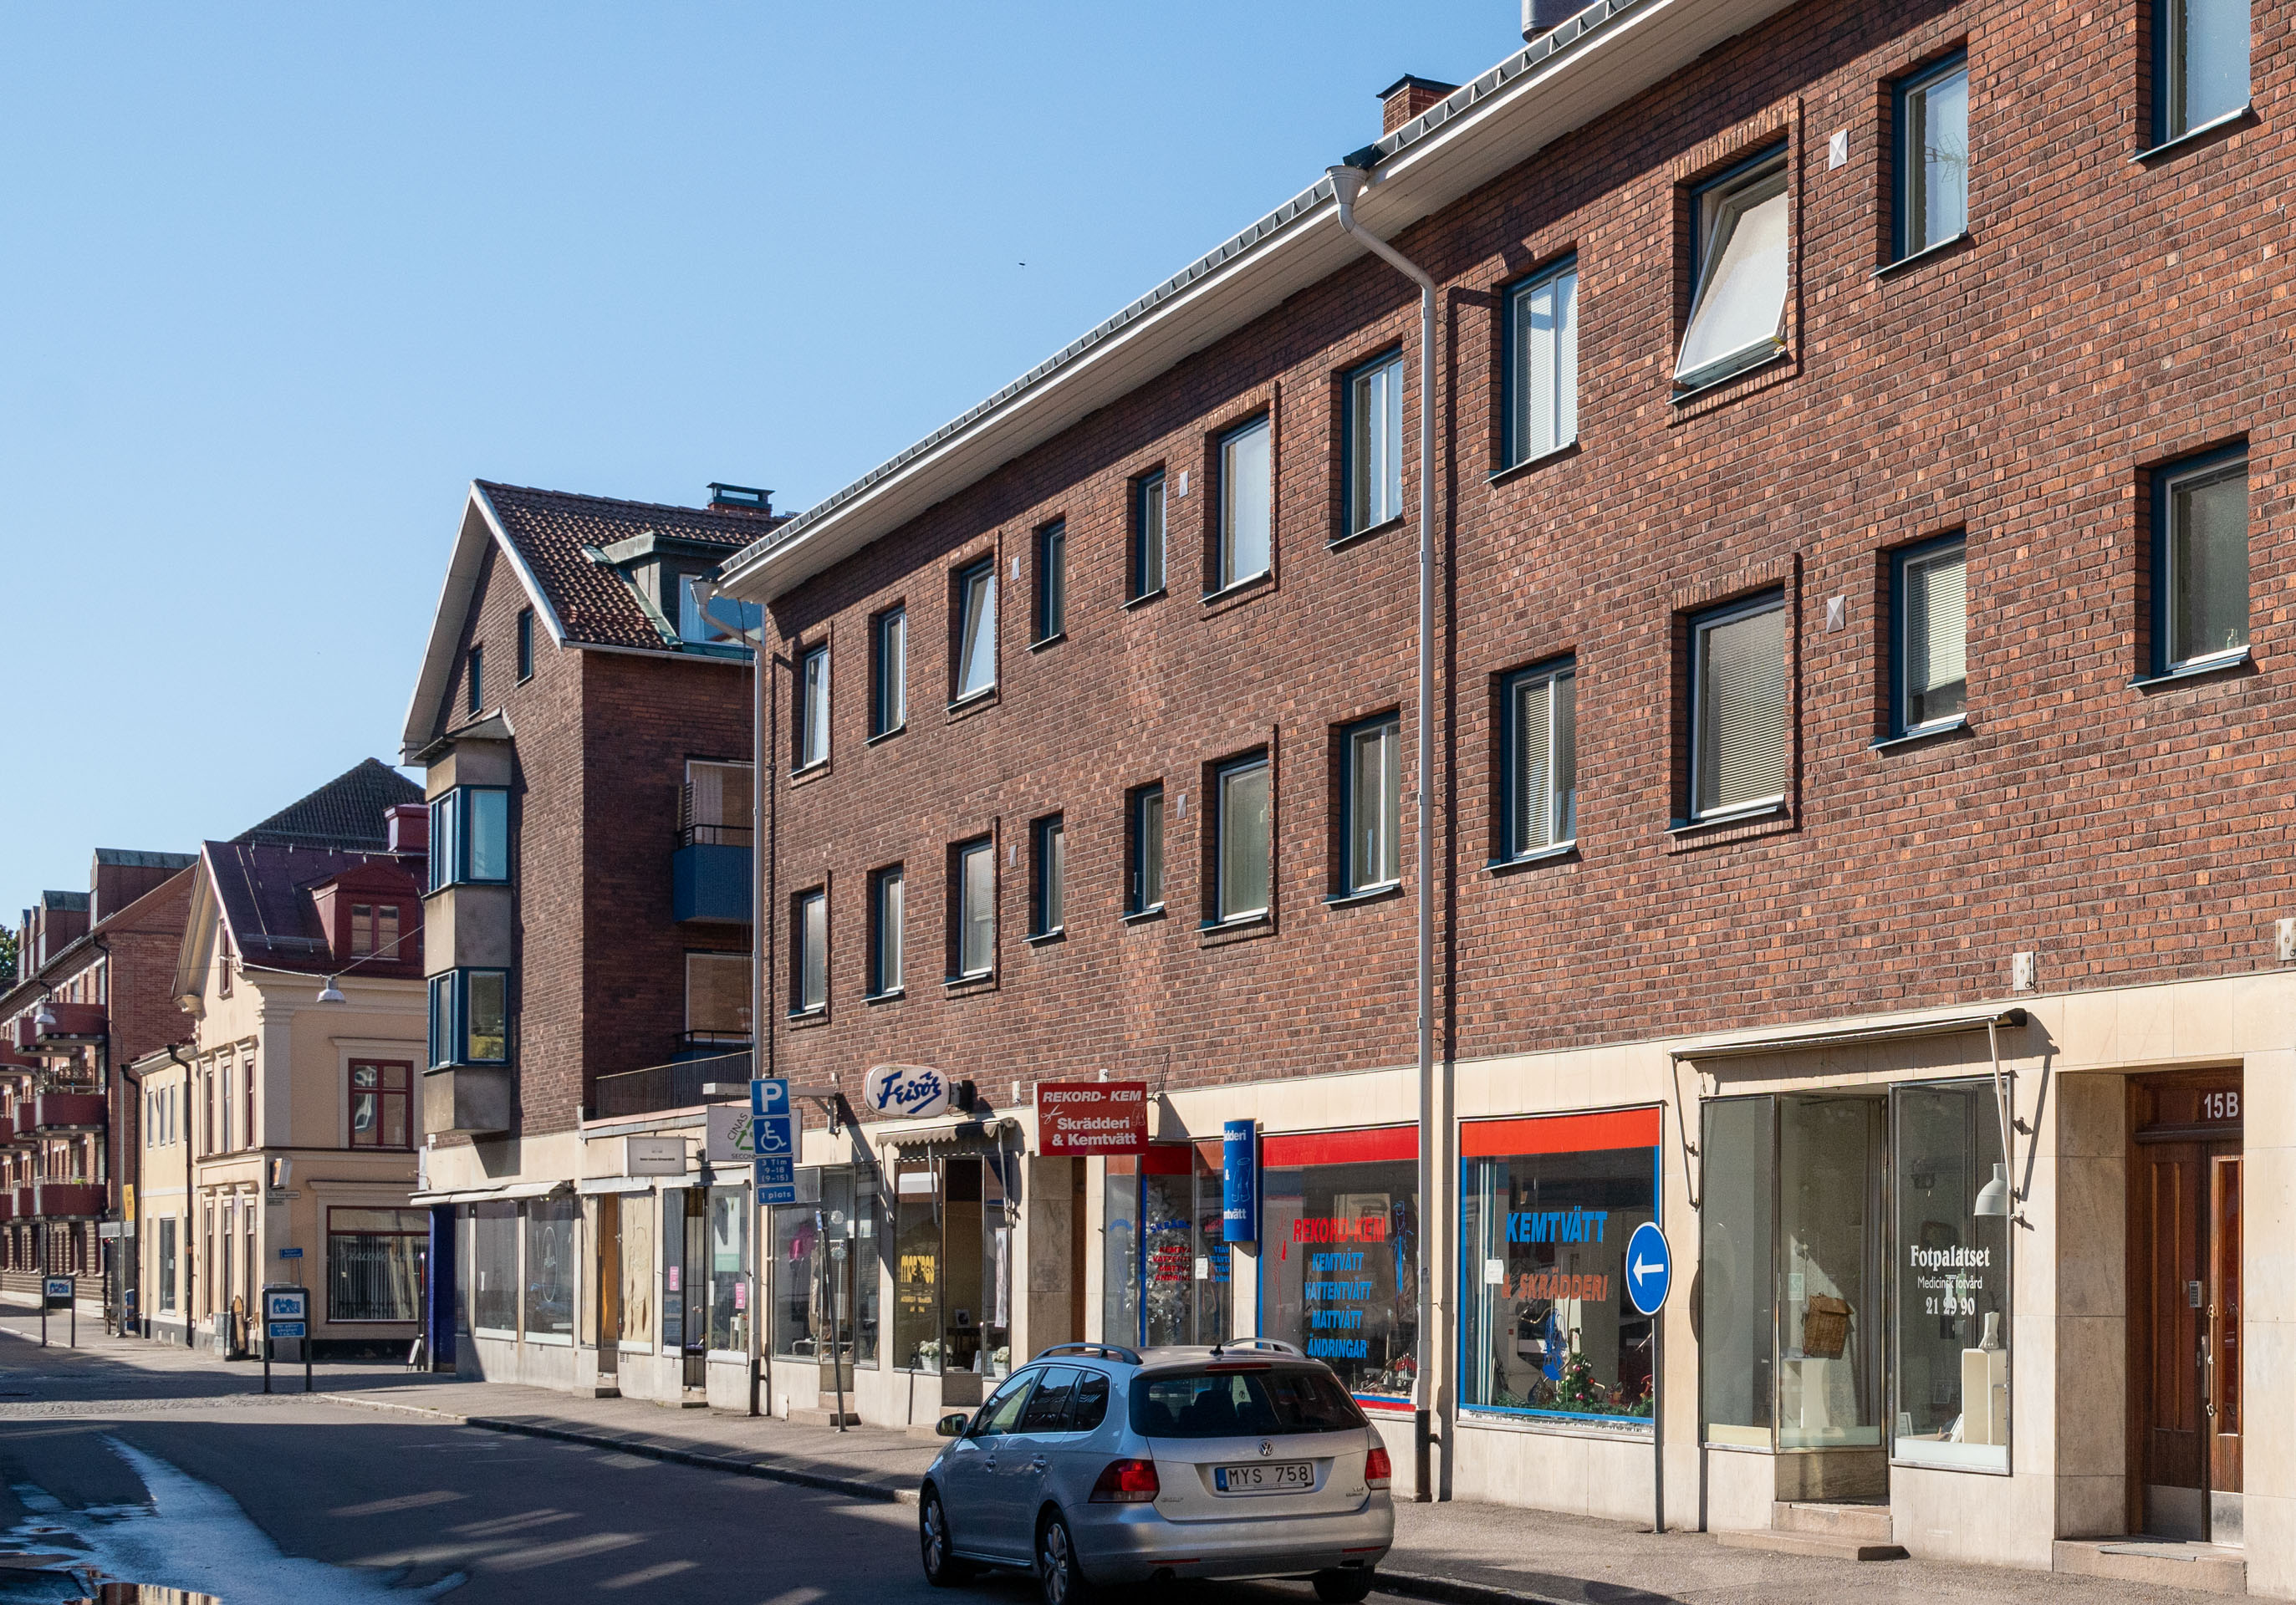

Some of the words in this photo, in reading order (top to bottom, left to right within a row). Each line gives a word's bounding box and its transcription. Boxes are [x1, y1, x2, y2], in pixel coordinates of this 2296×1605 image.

[760, 1083, 783, 1113] P
[876, 1070, 942, 1113] Frisör
[1043, 1091, 1106, 1103] REKORD-
[1110, 1090, 1142, 1102] KEM
[2204, 1092, 2239, 1118] 15B
[727, 1113, 748, 1140] CINAS
[1057, 1117, 1130, 1129] Skrädderi
[1052, 1134, 1064, 1146] &
[1068, 1133, 1137, 1146] Kemtvätt
[768, 1190, 792, 1200] plats
[1293, 1217, 1386, 1243] REKORD-KEM
[1505, 1205, 1608, 1243] KEMTVÄTT
[1312, 1247, 1364, 1271] KEMTVÄTT
[1911, 1245, 1990, 1271] Fotpalatset
[1304, 1276, 1372, 1300] VATTENTVÄTT
[1502, 1273, 1512, 1298] &
[1518, 1266, 1609, 1302] SKRÄDDERI
[1917, 1276, 1954, 1289] Medicinsk
[1956, 1275, 1982, 1289] fotvård
[1311, 1305, 1363, 1329] MATTVÄTT
[1926, 1297, 1938, 1314] 21
[1961, 1297, 1975, 1315] 90
[1307, 1332, 1367, 1358] ÄNDRINGAR
[1228, 1468, 1263, 1485] MYS
[1275, 1466, 1309, 1483] 758
